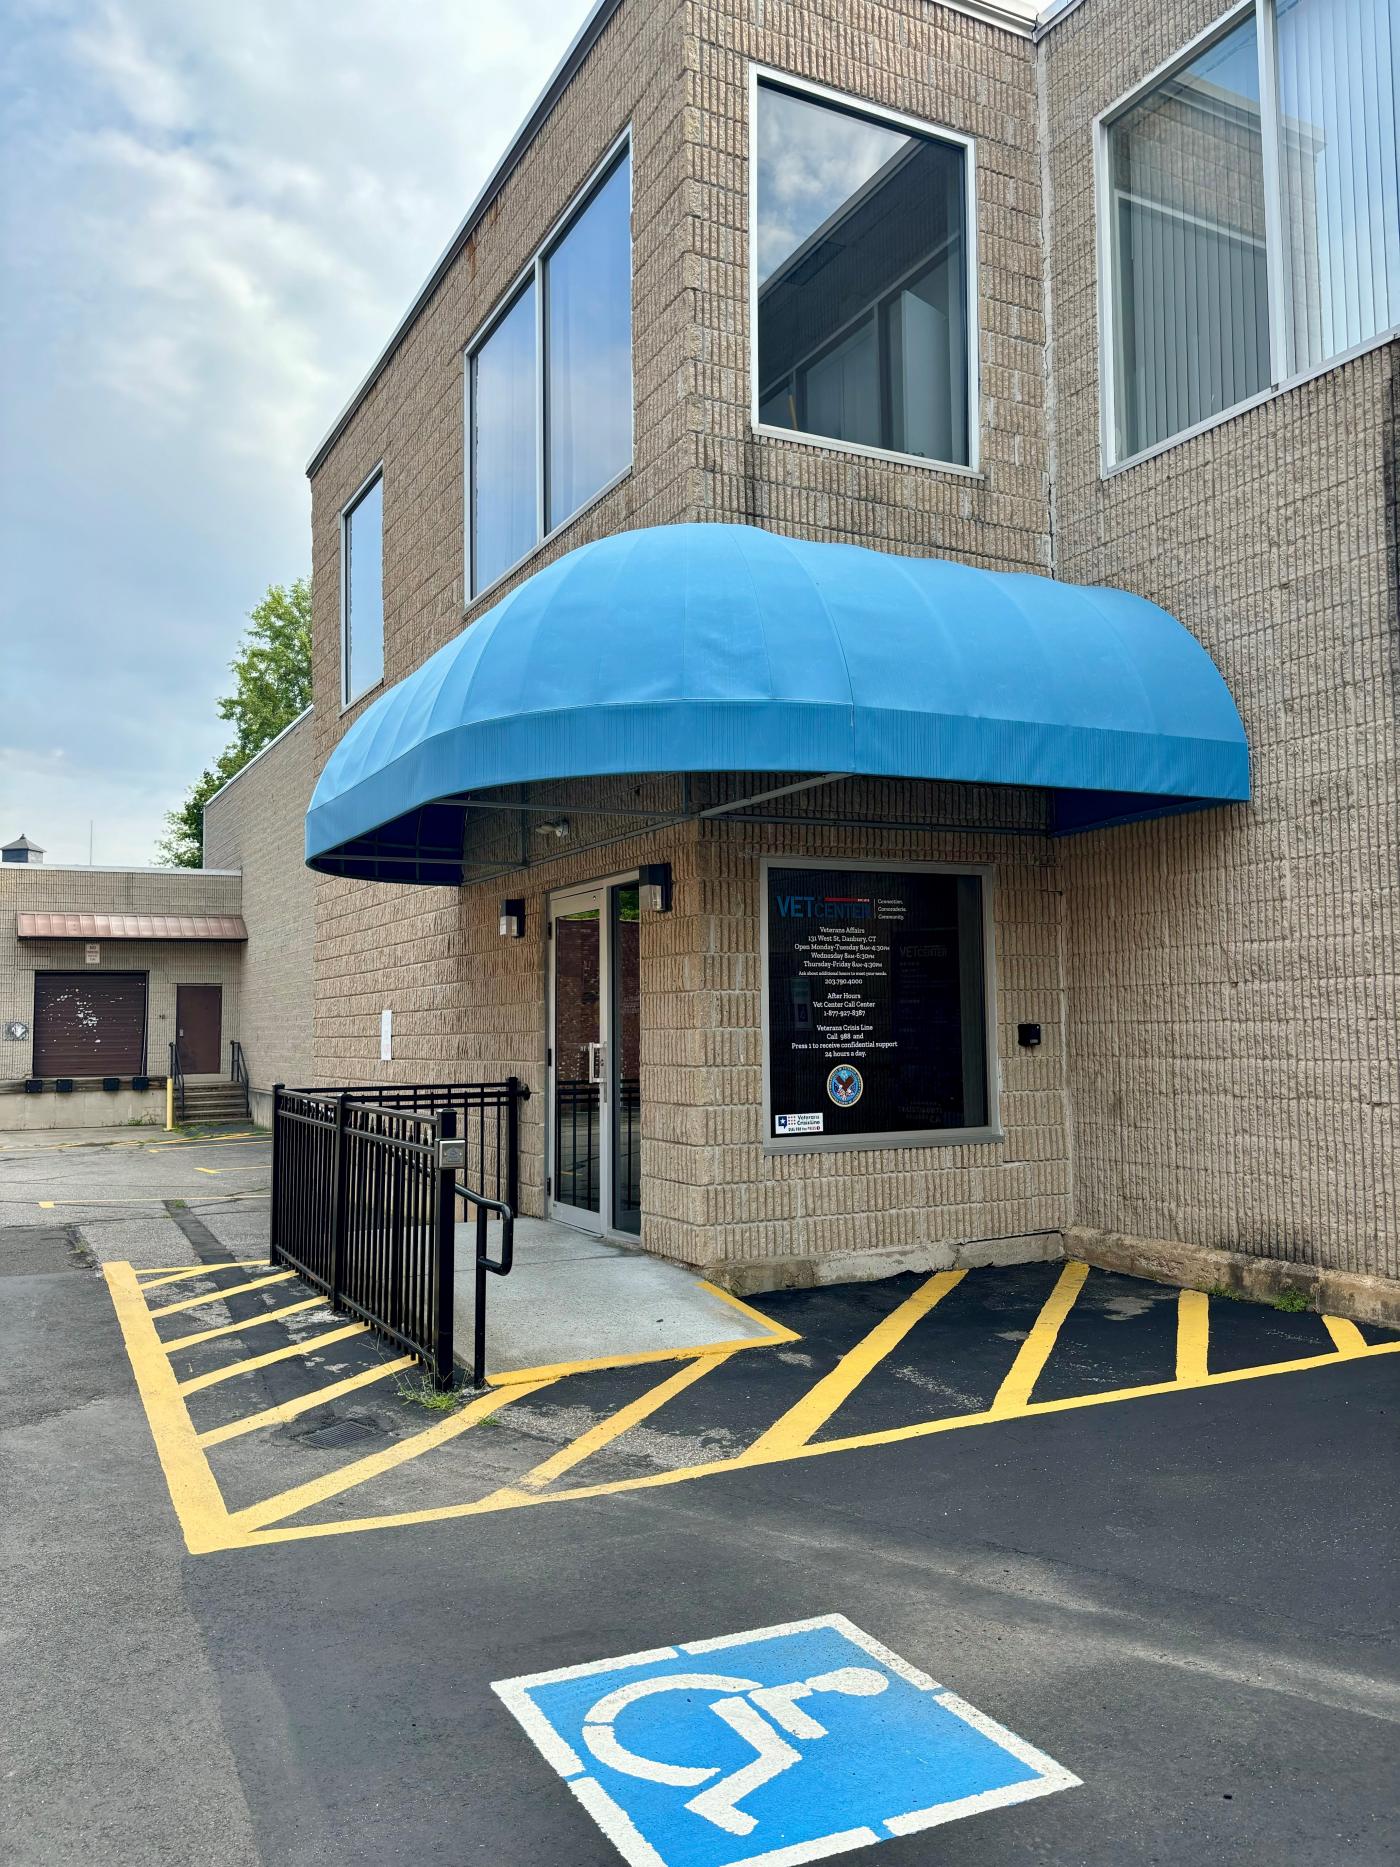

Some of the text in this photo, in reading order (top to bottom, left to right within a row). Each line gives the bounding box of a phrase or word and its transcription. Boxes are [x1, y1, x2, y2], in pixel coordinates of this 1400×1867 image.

[820, 926, 865, 934] Veterans Affairs
[842, 935, 867, 943] Danbury,
[794, 943, 810, 951] Open
[811, 943, 859, 952] Monday-Tuesday
[811, 952, 843, 960] Wednesday
[803, 960, 851, 969] Thursday-Friday
[823, 1009, 865, 1017] 1-877-927-8387
[875, 1041, 898, 1049] support
